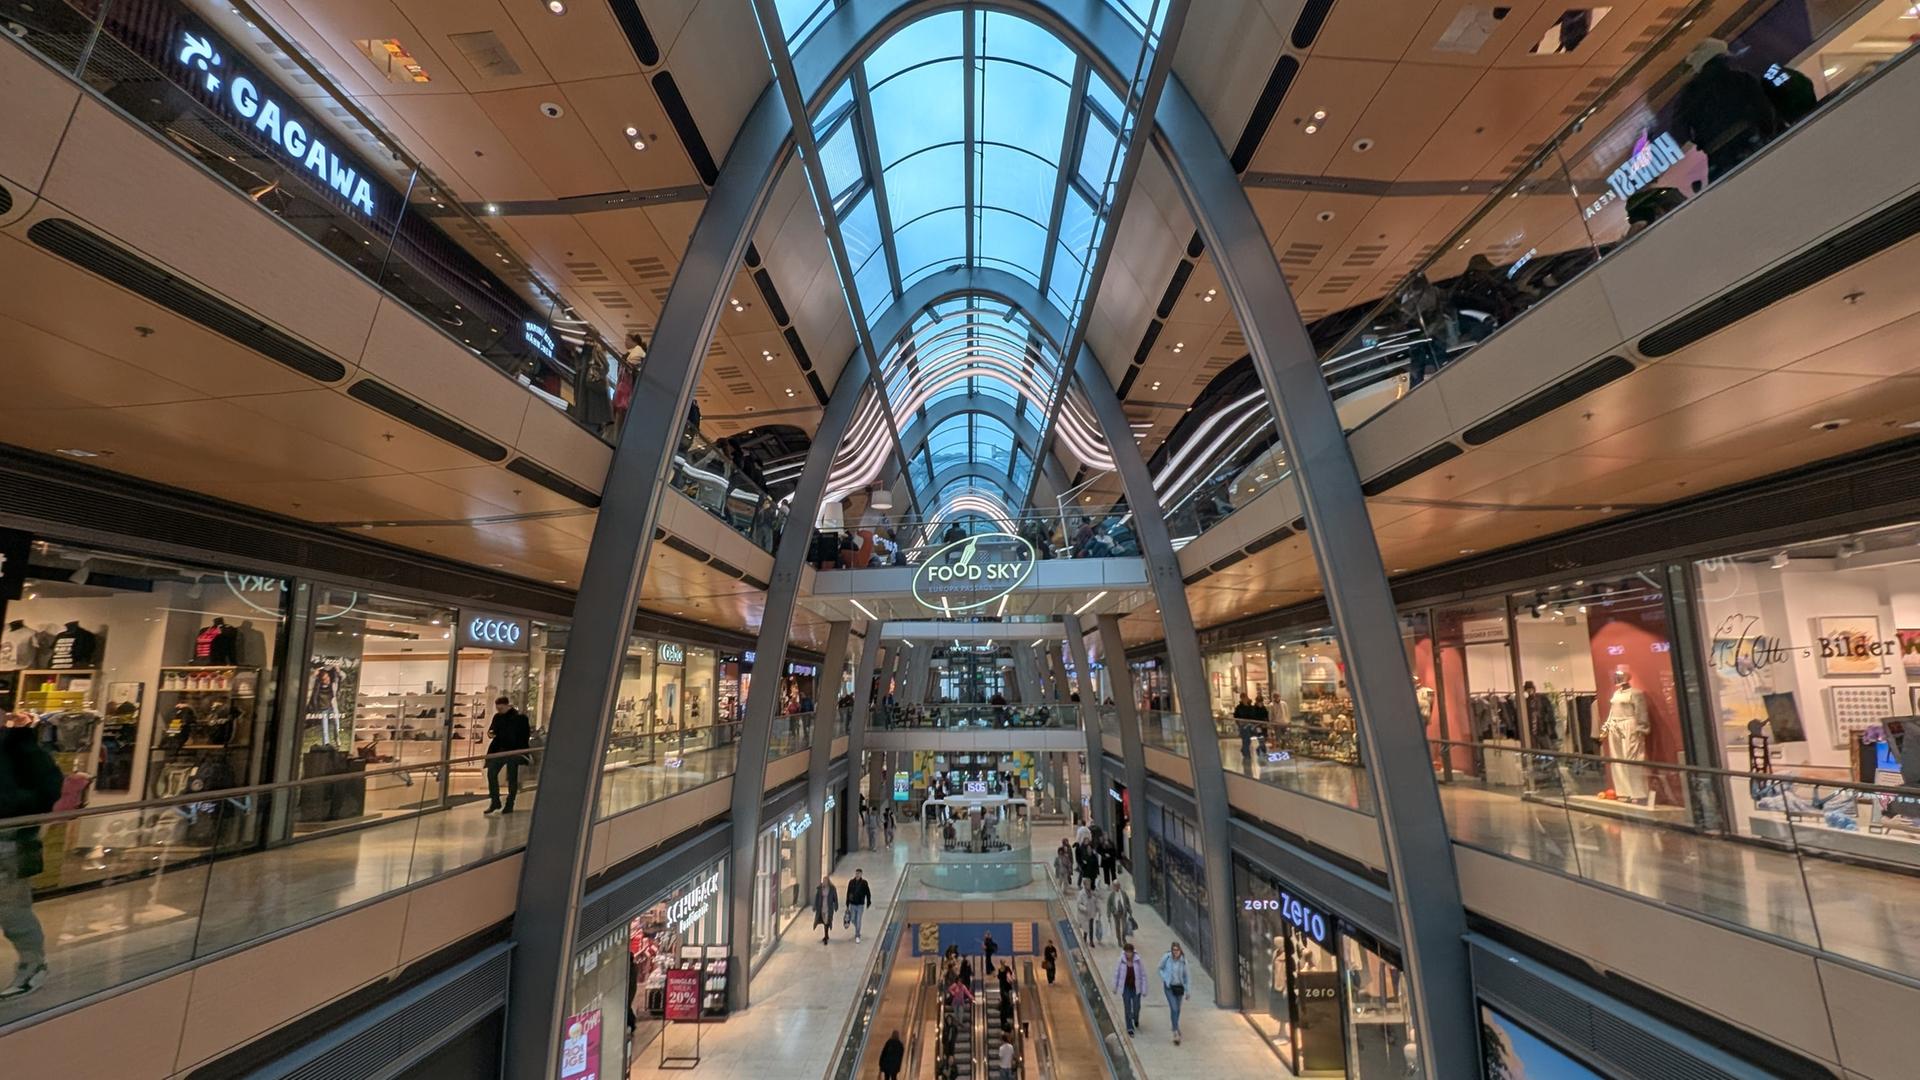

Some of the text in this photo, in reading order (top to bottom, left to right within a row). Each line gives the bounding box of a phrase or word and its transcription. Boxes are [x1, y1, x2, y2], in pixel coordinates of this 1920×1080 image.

[231, 77, 374, 216] GAGAWA
[928, 562, 1022, 582] FOOD SKY
[471, 618, 520, 643] ecco
[1244, 900, 1279, 910] zero
[1281, 892, 1326, 942] zero
[669, 991, 696, 1004] 20%
[1305, 988, 1335, 998] zero
